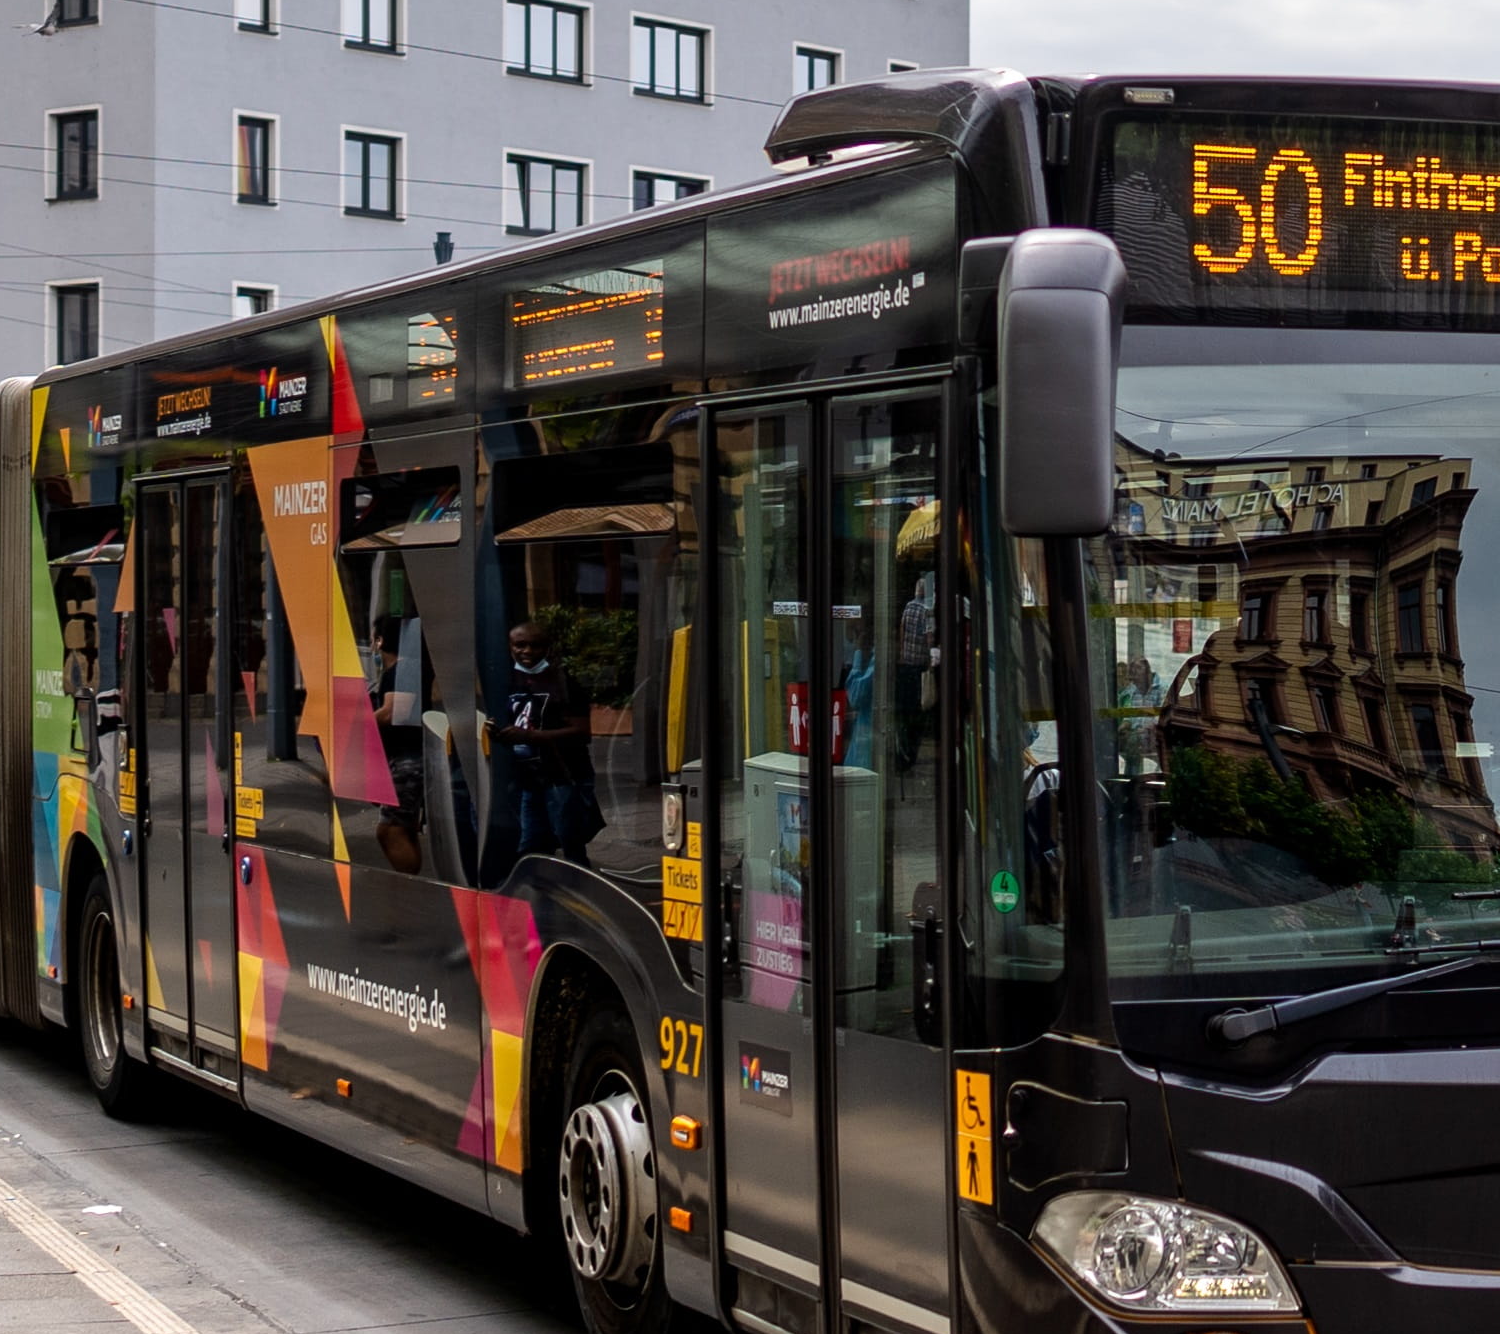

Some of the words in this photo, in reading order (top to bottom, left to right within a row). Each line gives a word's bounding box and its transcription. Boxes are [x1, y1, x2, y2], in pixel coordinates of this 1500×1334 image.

[1194, 144, 1322, 275] 50
[768, 256, 812, 306] JETZT
[769, 278, 910, 329] www.mainzerenergie.de
[278, 375, 308, 399] MAINZER
[274, 480, 328, 517] MAINZER
[310, 522, 328, 546] GAS
[667, 865, 698, 890] Tickets
[1000, 872, 1009, 892] 4
[756, 919, 777, 940] HIER
[756, 947, 794, 973] ZUSTIEG
[307, 962, 446, 1032] www.mainzerenergie.de
[660, 1016, 704, 1078] 927
[761, 1070, 789, 1089] MAINZER
